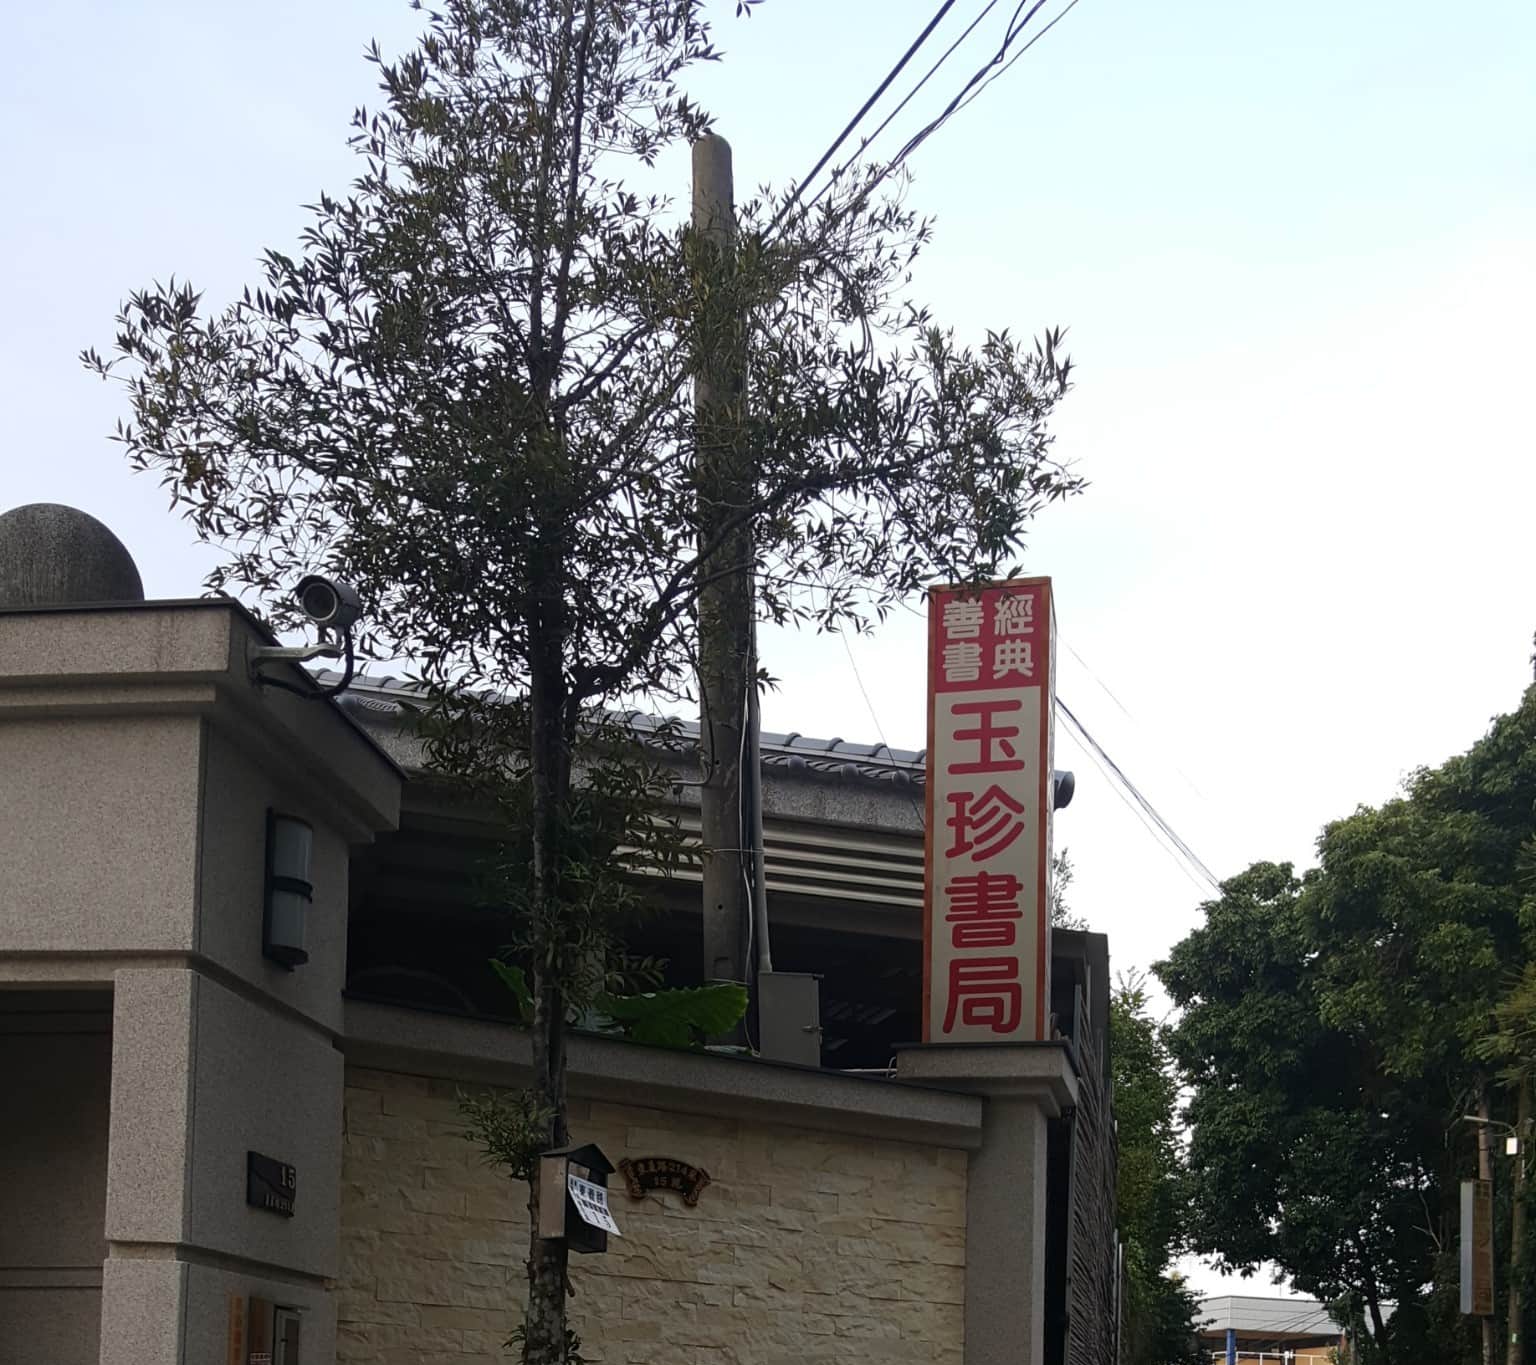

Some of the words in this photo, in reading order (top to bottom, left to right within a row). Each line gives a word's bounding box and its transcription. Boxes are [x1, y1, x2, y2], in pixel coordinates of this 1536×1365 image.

[941, 599, 985, 683] 善書
[993, 593, 1035, 679] 經典
[941, 699, 1026, 1035] 玉珍書局
[281, 1166, 296, 1190] 15
